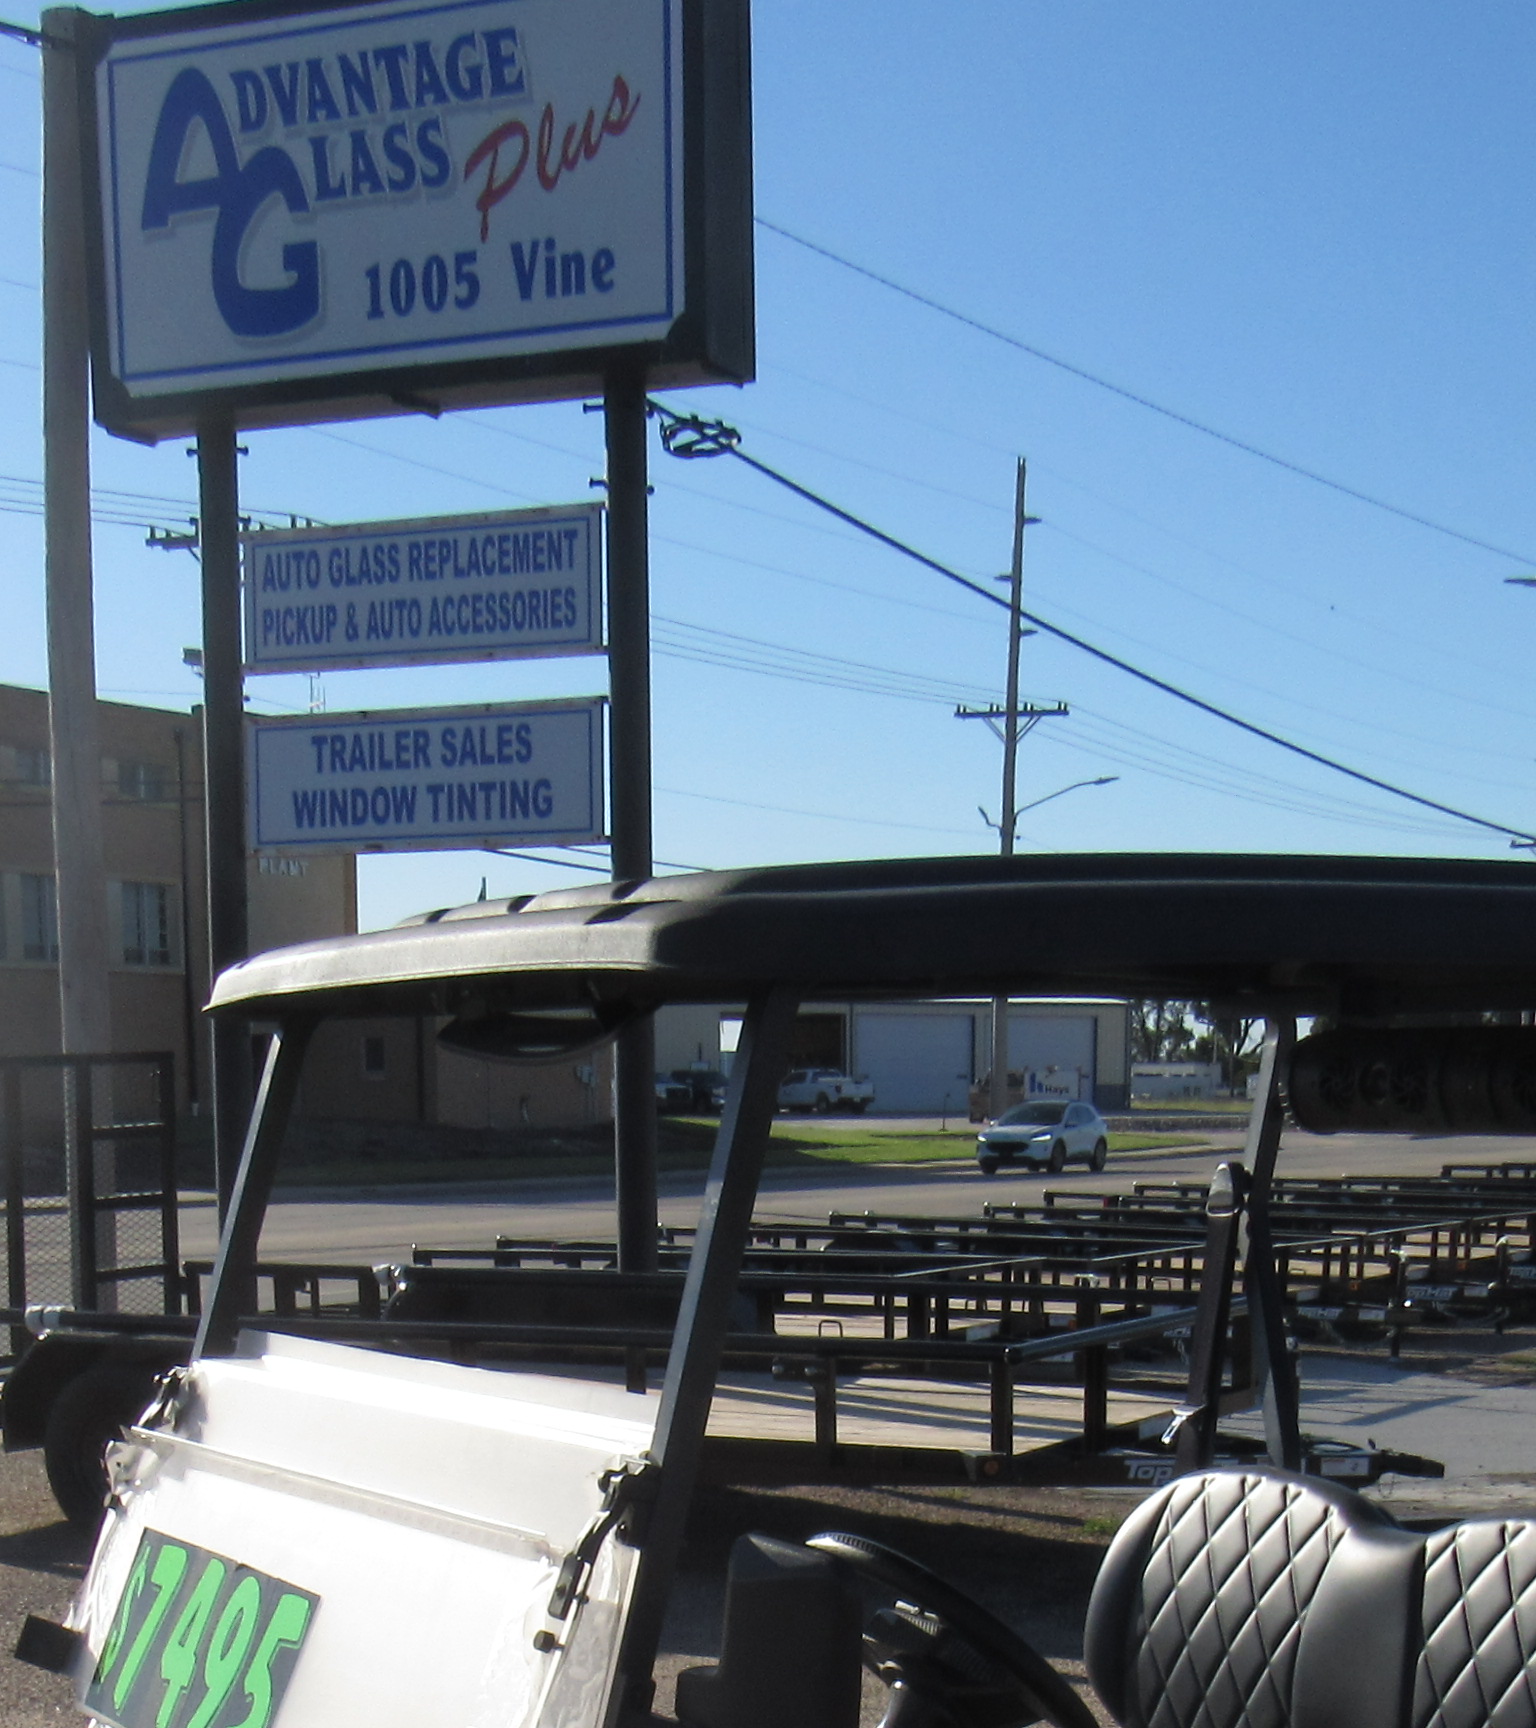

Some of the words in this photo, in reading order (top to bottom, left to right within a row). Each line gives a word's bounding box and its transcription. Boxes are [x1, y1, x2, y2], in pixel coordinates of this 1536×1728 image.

[464, 75, 641, 242] Plus
[365, 251, 479, 319] 1005
[510, 236, 615, 302] Vine
[264, 549, 320, 592] AUTO
[329, 543, 400, 586] GLASS
[409, 530, 578, 582] REPLACEMENT
[264, 606, 338, 646] PICKUP
[346, 606, 359, 642] &
[367, 601, 422, 641] AUTO
[429, 588, 577, 637] ACCESSORIES
[312, 730, 431, 774] TRAILER
[441, 725, 533, 768] SALES
[293, 786, 417, 828] WINDOW
[427, 778, 553, 822] TINTING
